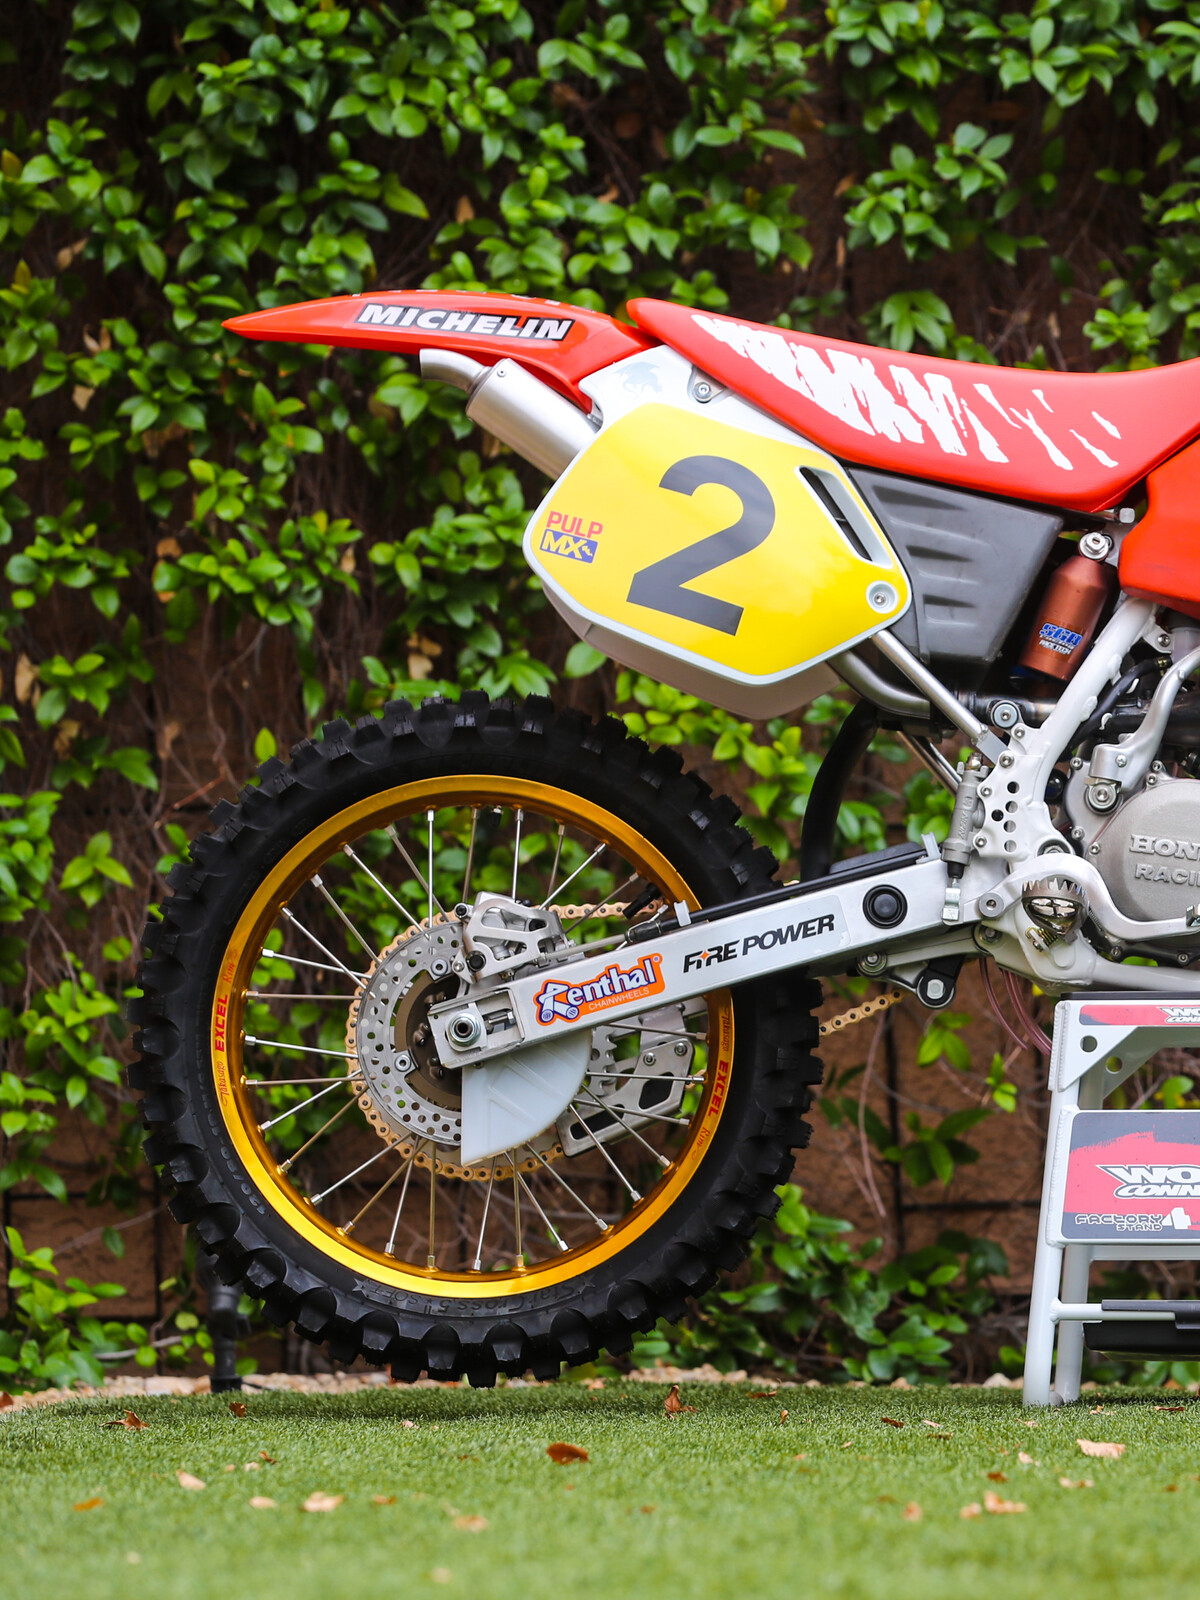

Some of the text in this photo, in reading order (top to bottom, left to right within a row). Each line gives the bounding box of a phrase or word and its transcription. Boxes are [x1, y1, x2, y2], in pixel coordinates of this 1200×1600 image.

[357, 304, 573, 340] MICHELIN
[542, 531, 589, 559] MX
[546, 511, 603, 539] PULP
[626, 455, 776, 637] 2
[683, 913, 836, 974] FIRE POWER
[540, 957, 657, 1020] Renthal
[588, 986, 650, 1012] CHAINWHEELS
[215, 994, 229, 1053] EXCEL
[708, 1060, 729, 1117] EXCEL
